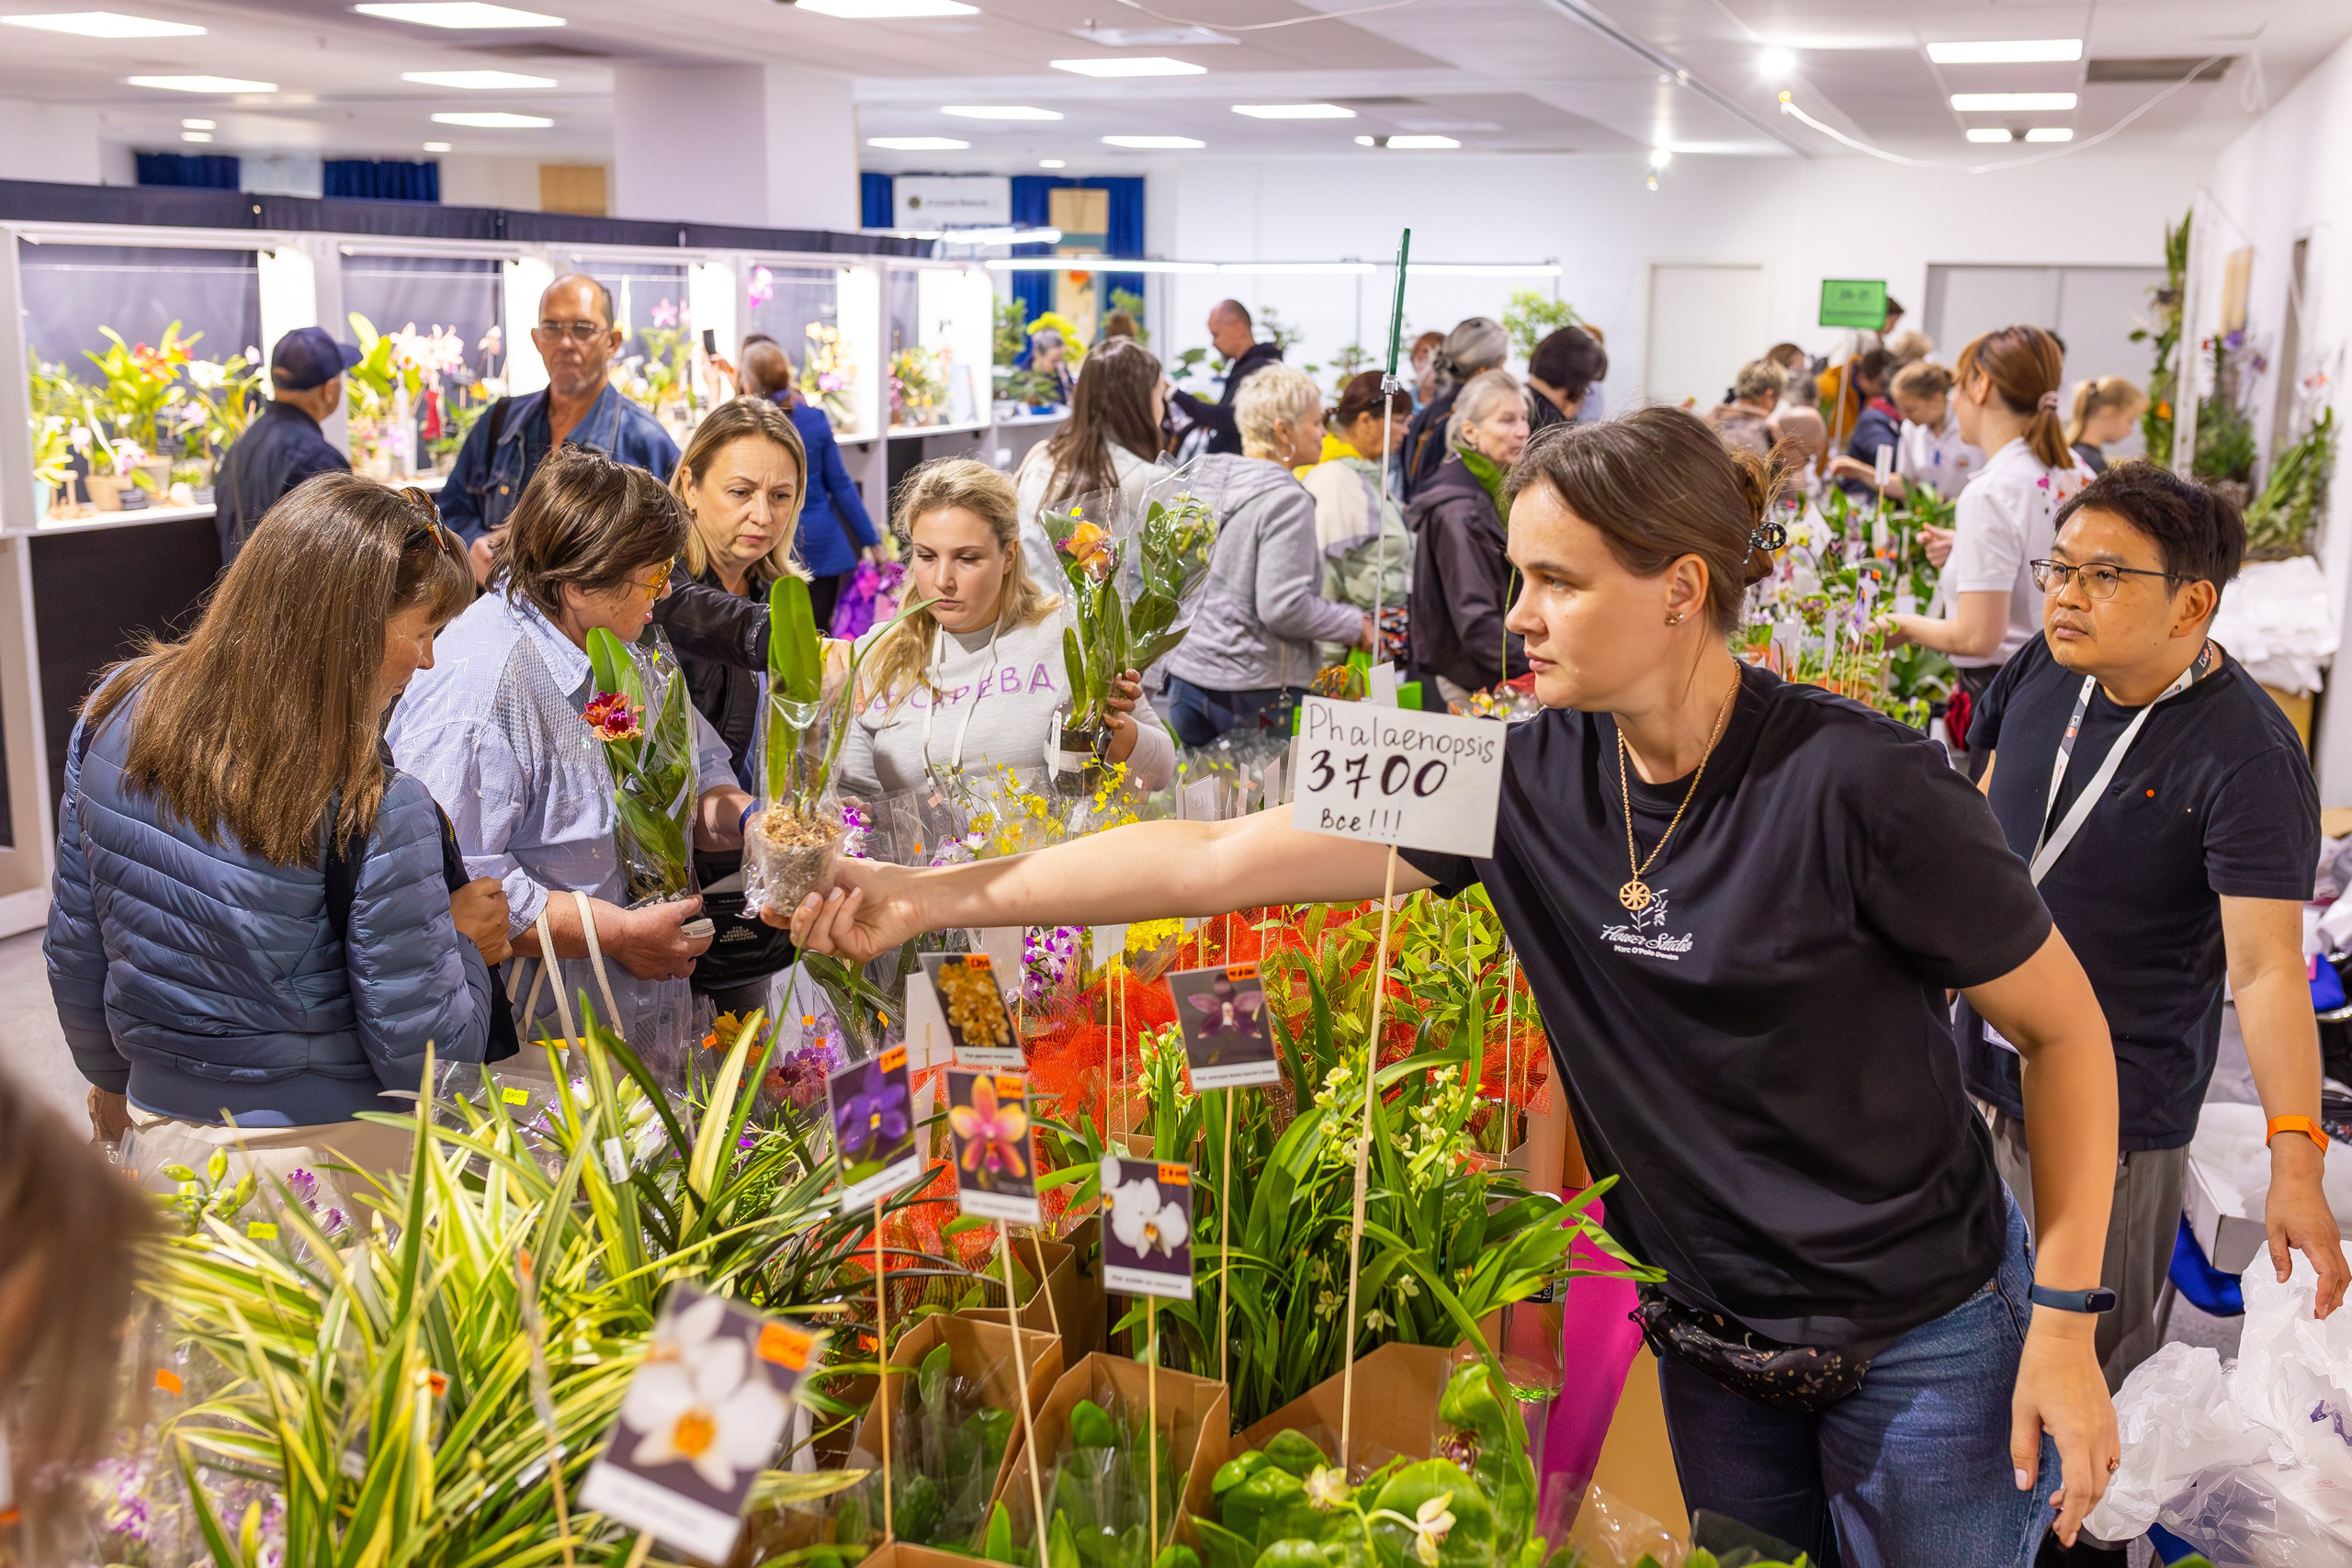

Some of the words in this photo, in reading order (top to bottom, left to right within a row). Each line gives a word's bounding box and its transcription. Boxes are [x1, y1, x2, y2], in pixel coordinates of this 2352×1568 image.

[1309, 703, 1495, 766] Phalaenopsis
[1307, 750, 1447, 799] 3700
[1320, 808, 1401, 838] Все!!!
[1600, 924, 1646, 945] Flower
[1645, 932, 1693, 953] Studio
